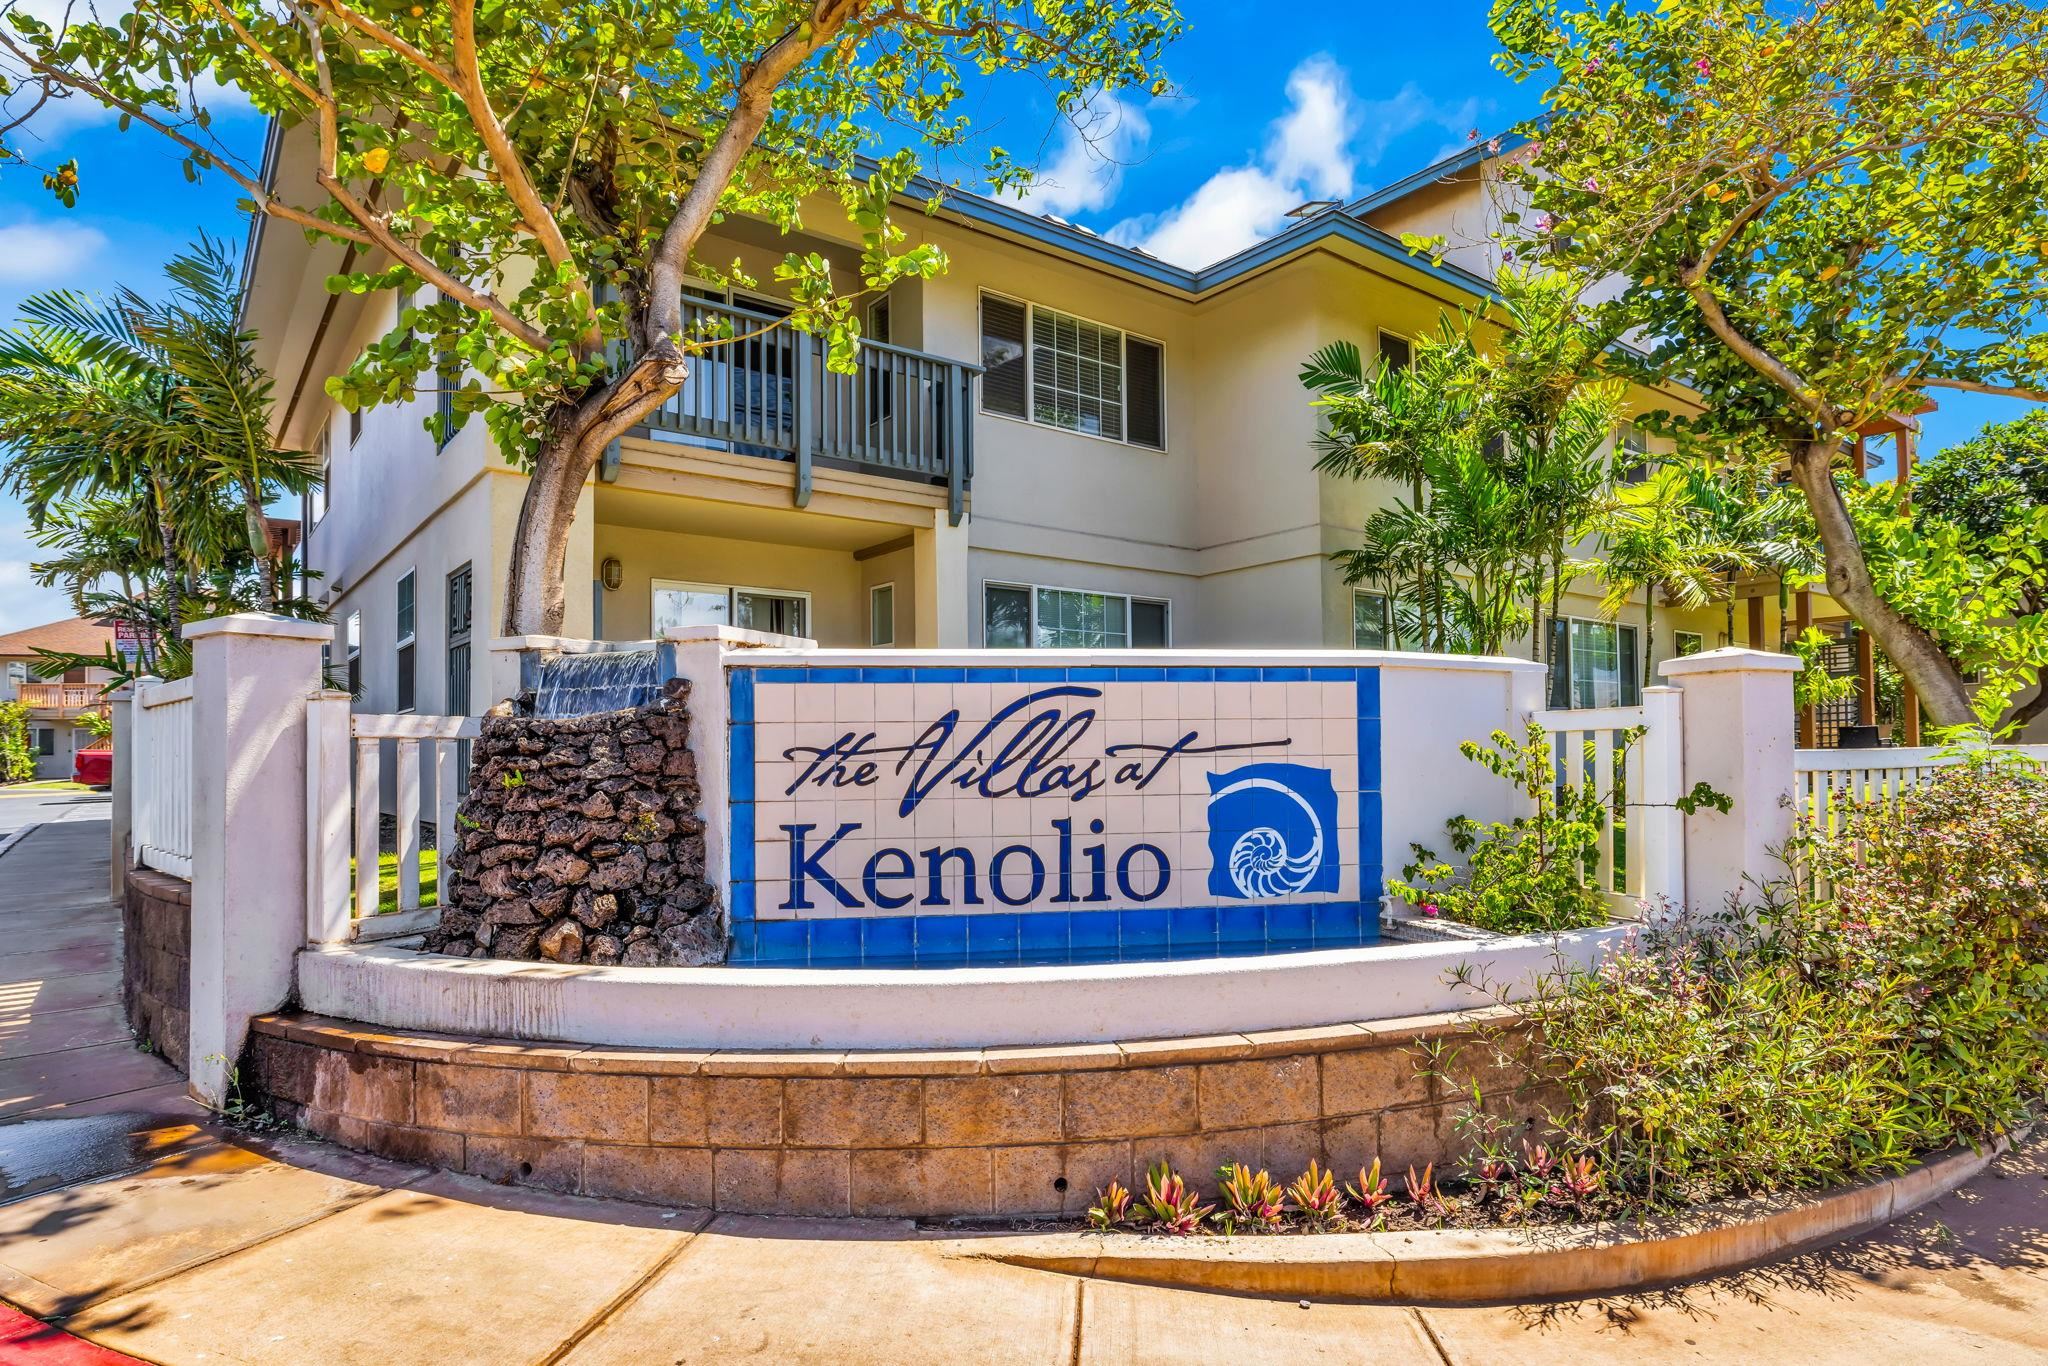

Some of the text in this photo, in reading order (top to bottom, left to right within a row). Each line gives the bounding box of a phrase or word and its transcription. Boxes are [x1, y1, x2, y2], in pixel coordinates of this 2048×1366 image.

[784, 686, 1292, 817] the Villas at
[778, 818, 1171, 910] Kenolio
